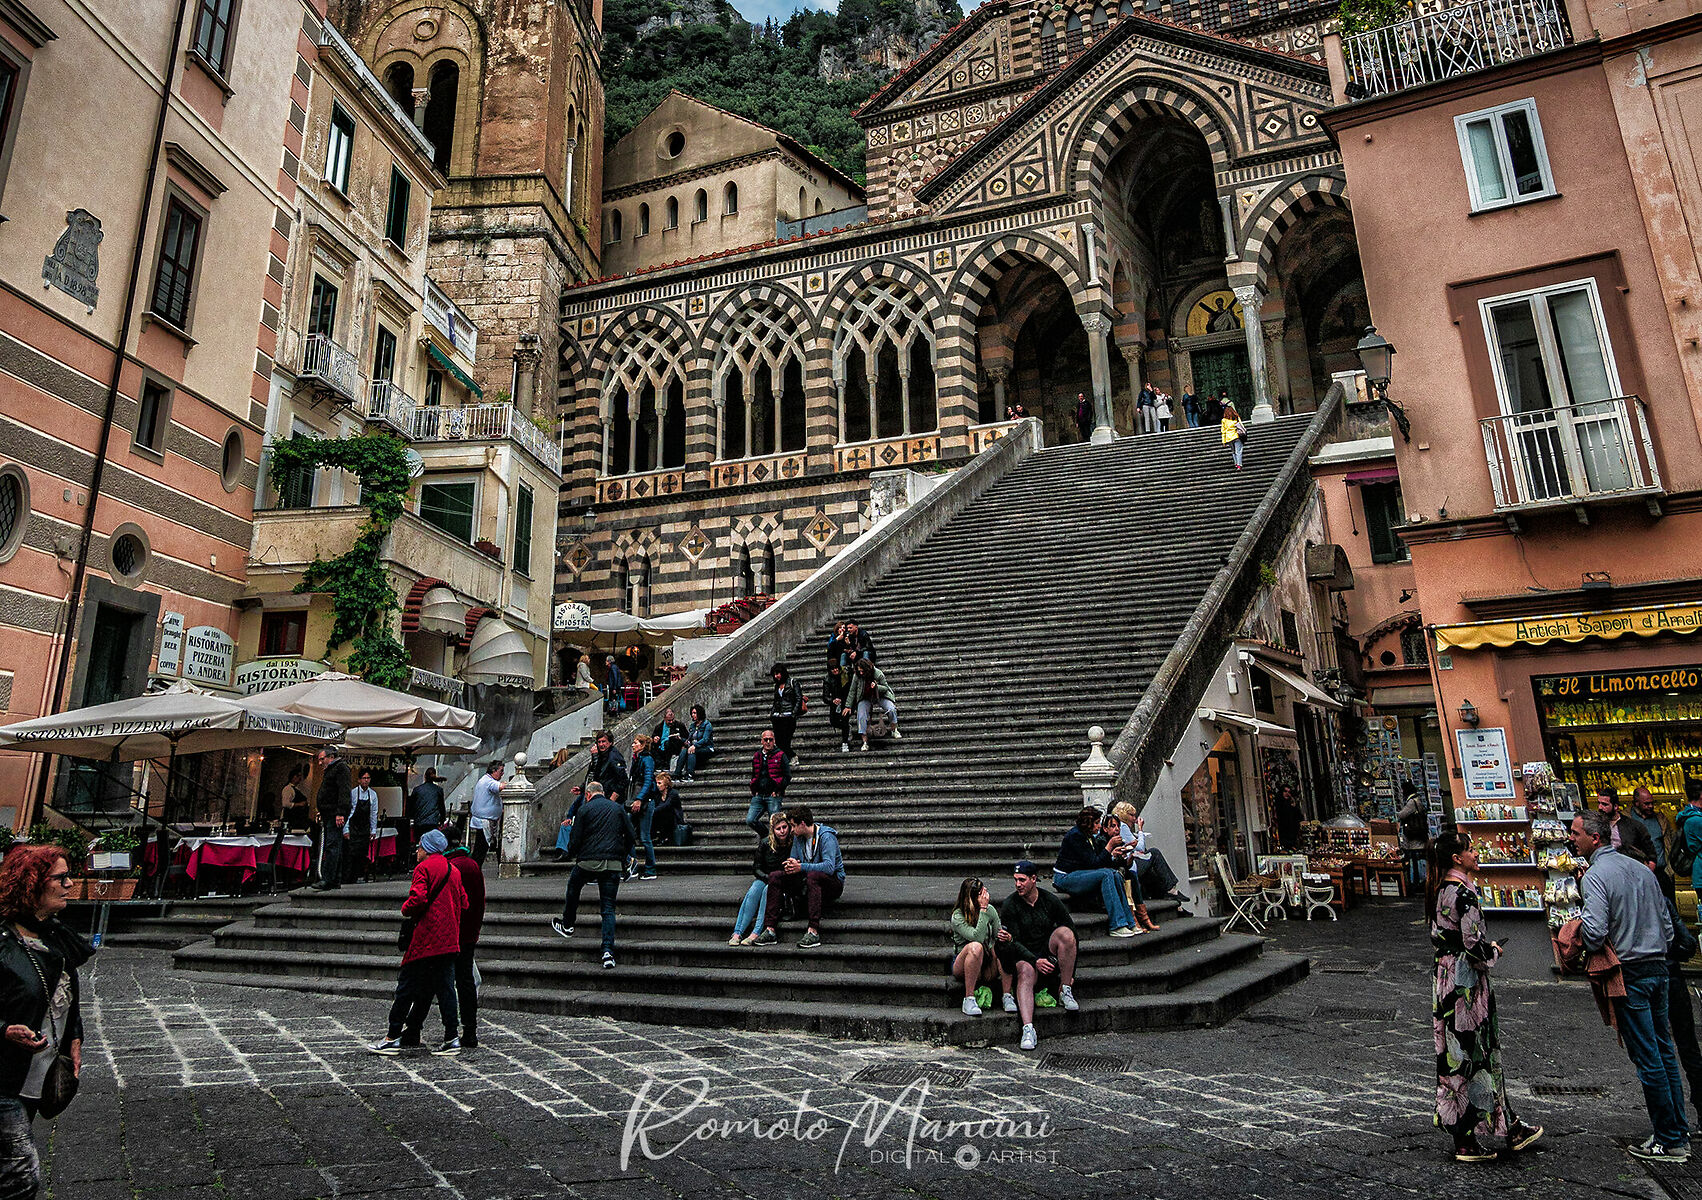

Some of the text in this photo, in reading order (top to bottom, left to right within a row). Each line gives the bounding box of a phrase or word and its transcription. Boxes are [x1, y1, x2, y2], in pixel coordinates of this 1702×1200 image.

[70, 279, 87, 297] 1898
[556, 603, 589, 620] RISTORANTE
[554, 619, 590, 627] CHIOSTRO
[1516, 619, 1570, 640] Antichi
[1576, 614, 1633, 635] Sapori
[188, 635, 232, 655] RISTORANTE
[159, 660, 177, 670] COFFEE
[192, 650, 225, 668] PIZZERIA
[187, 663, 226, 681] S. ANDREA
[1590, 670, 1698, 694] Limoncello
[15, 717, 211, 742] RISTORANTE PIZZERIA BAR
[270, 718, 290, 732] WINE
[292, 721, 326, 738] DRAUGHT
